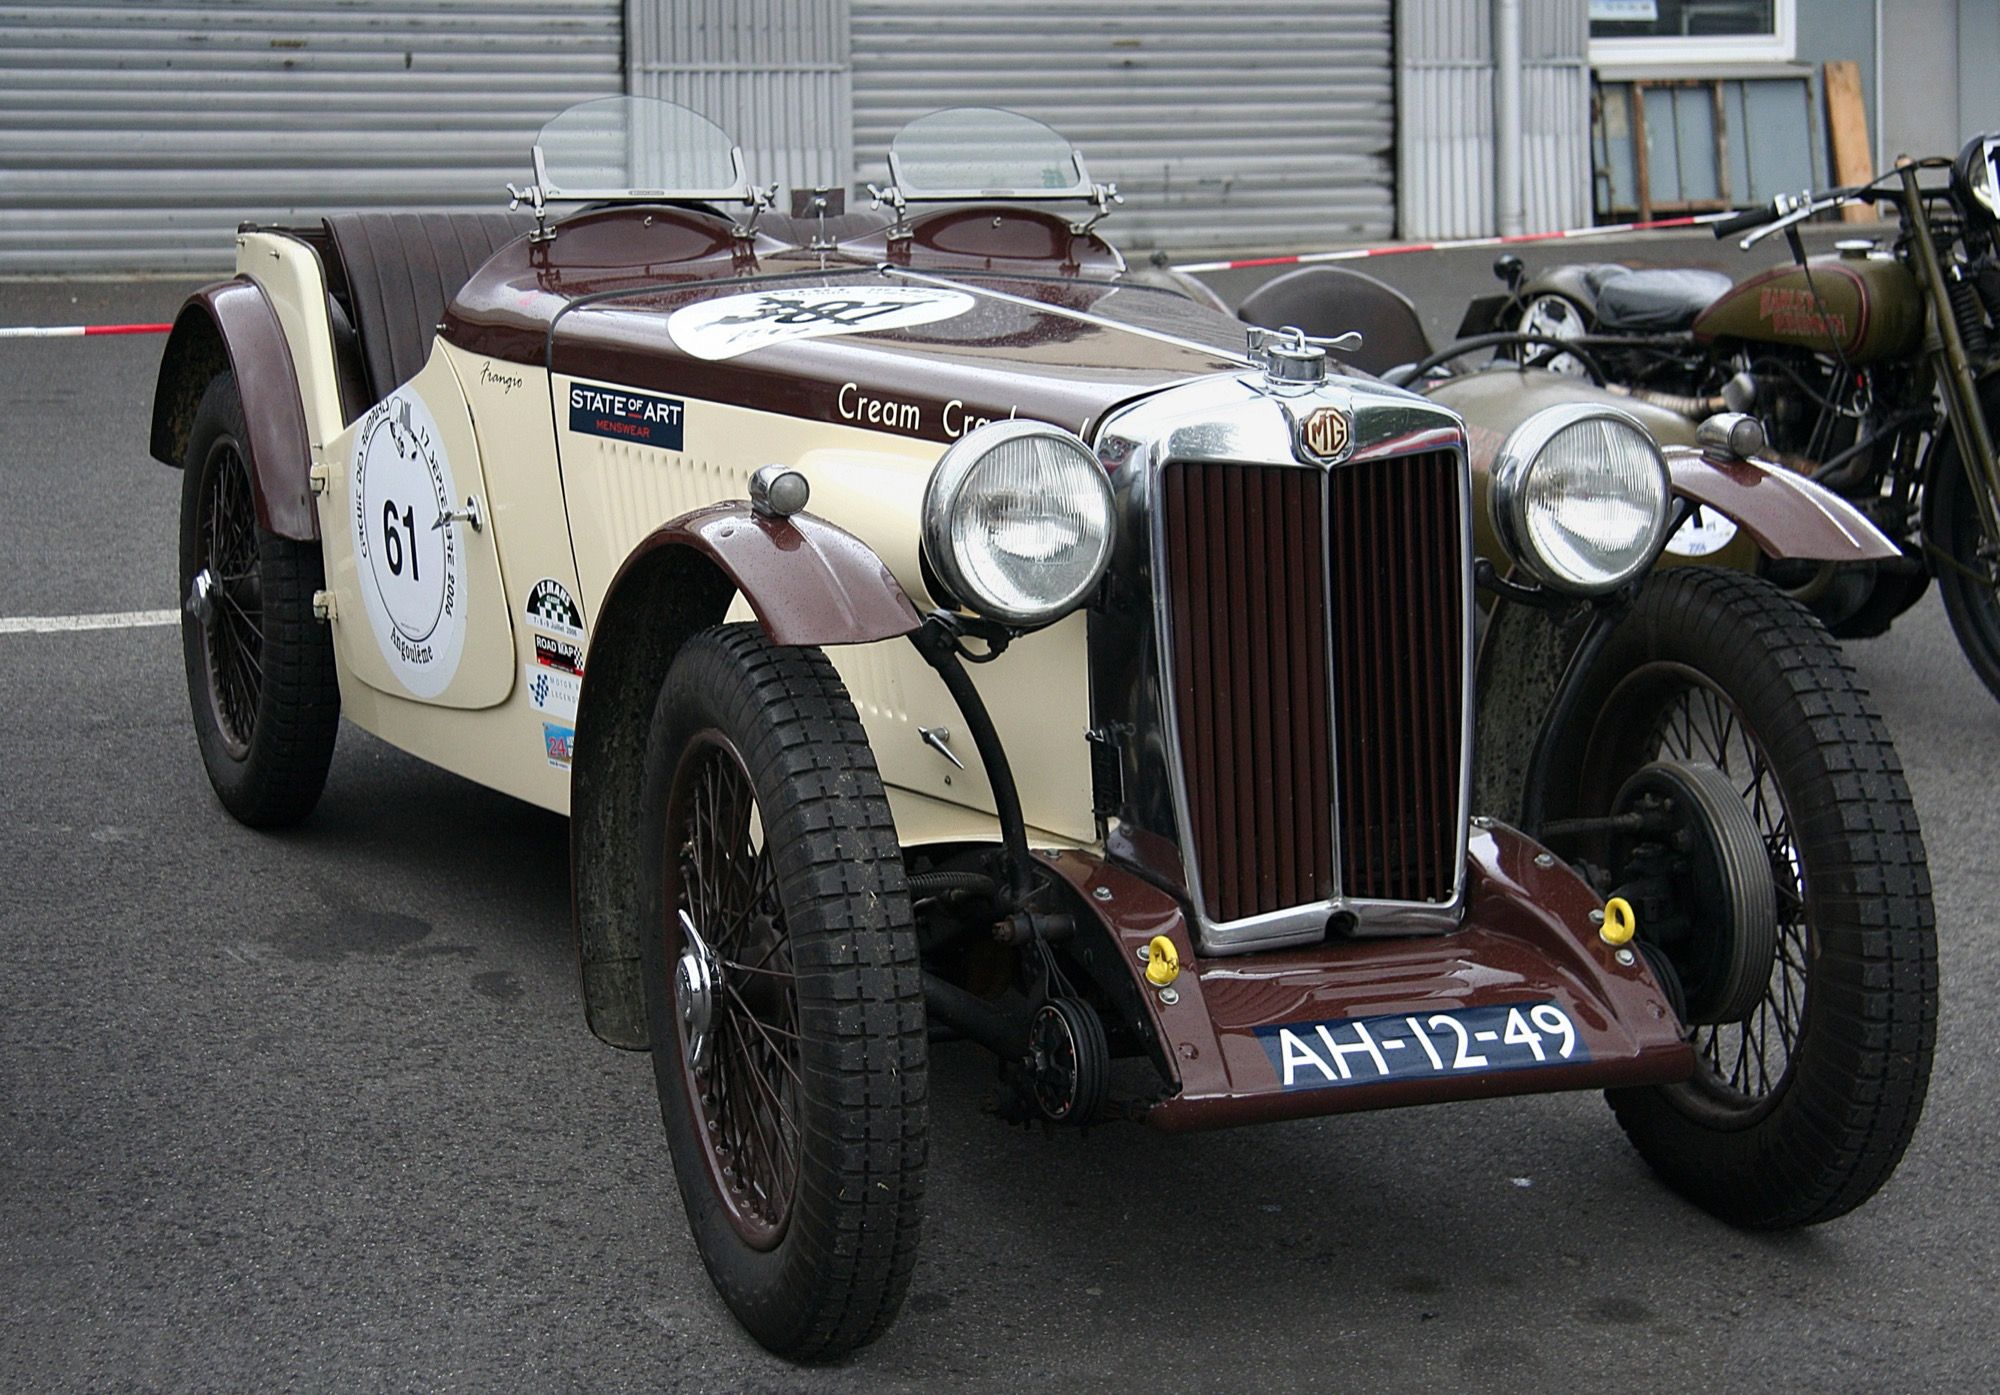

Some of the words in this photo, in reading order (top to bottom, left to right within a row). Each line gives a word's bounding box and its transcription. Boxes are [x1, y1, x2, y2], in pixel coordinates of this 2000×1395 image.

[571, 389, 627, 416] STATE
[628, 398, 644, 412] OF
[643, 402, 682, 426] ART
[838, 382, 920, 431] Cream
[596, 419, 651, 438] MENSWEAR
[1311, 414, 1345, 451] MG
[420, 425, 430, 448] 17
[429, 450, 455, 567] SEPTEBRE
[445, 572, 455, 618] 2006
[383, 499, 420, 582] 61
[390, 627, 434, 664] Angoulême
[536, 636, 557, 652] ROAD
[557, 643, 574, 657] MAP
[550, 676, 572, 689] MOTOR
[548, 736, 567, 757] 24
[1279, 1003, 1576, 1086] AH-12-49
